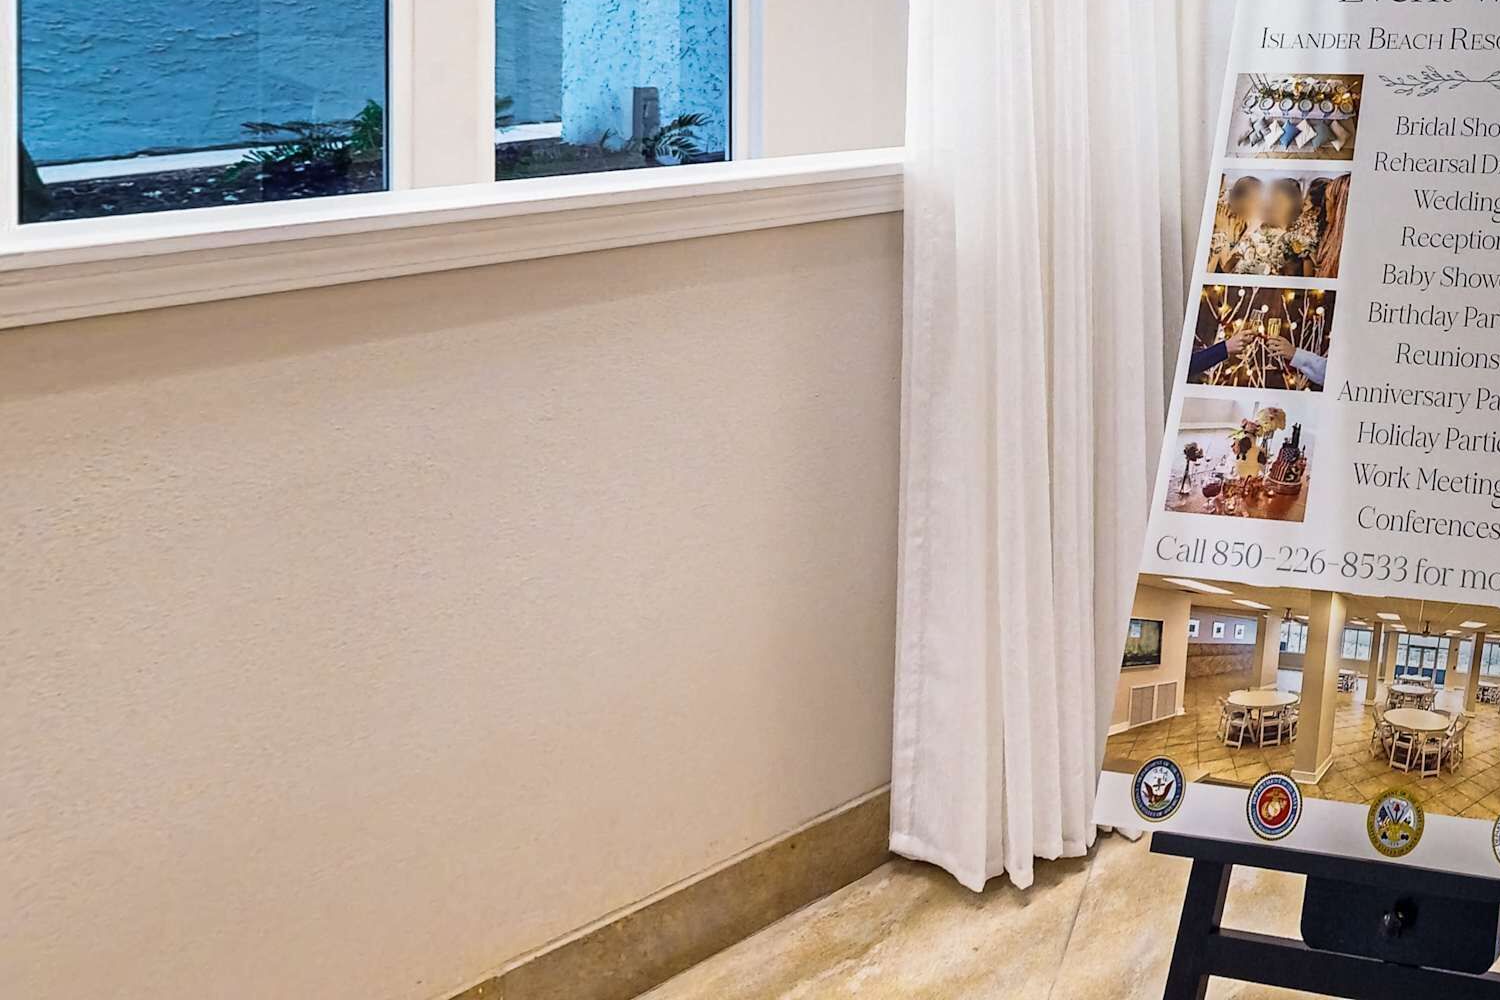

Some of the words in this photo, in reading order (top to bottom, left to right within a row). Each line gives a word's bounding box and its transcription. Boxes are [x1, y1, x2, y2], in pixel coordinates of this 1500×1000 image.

[1396, 115, 1458, 138] Bridal
[1374, 151, 1478, 175] Rehearsal
[1382, 264, 1436, 291] Baby
[1368, 301, 1461, 332] Birthday
[1395, 342, 1500, 369] Reunions
[1337, 380, 1472, 414] Anniversary
[1357, 421, 1442, 453] Holiday
[1353, 462, 1411, 489] Work
[1156, 536, 1207, 566] Call
[1212, 540, 1408, 582] 850-226-8533
[1414, 559, 1454, 587] for
